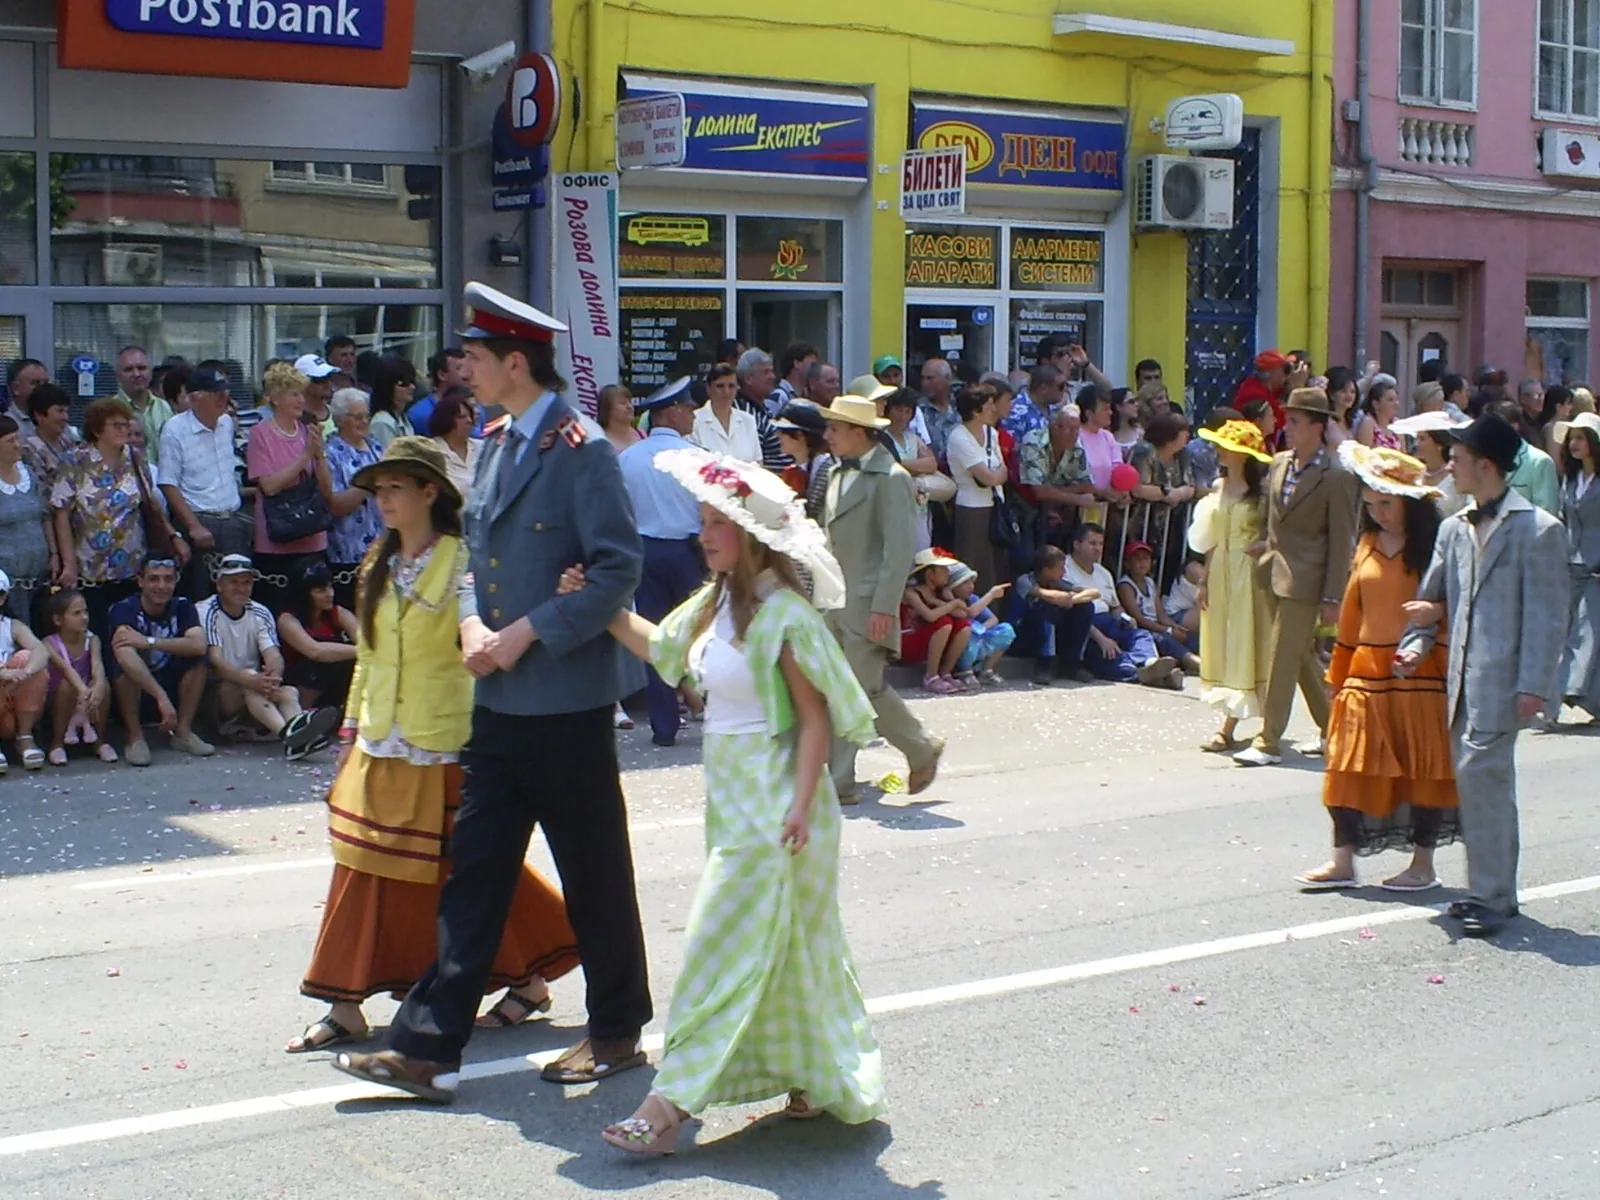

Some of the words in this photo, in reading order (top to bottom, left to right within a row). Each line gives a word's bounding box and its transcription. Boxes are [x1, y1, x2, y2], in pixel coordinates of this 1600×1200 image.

[140, 0, 360, 36] Postbank
[757, 121, 821, 150] ЕКСПРЕС
[998, 132, 1077, 178] ДЕН
[1081, 150, 1118, 178] ООД
[562, 174, 609, 188] ОФИС
[904, 154, 961, 192] БИЛЕТИ
[903, 195, 914, 210] ЗА
[916, 193, 935, 211] ЦЯЛ
[938, 191, 960, 207] СВЯТ
[910, 234, 992, 259] КАСОВИ
[1012, 238, 1100, 261] АЛАРМЕНИ
[906, 260, 994, 284] АПАРАТИ
[1018, 263, 1096, 285] СИСТЕМИ
